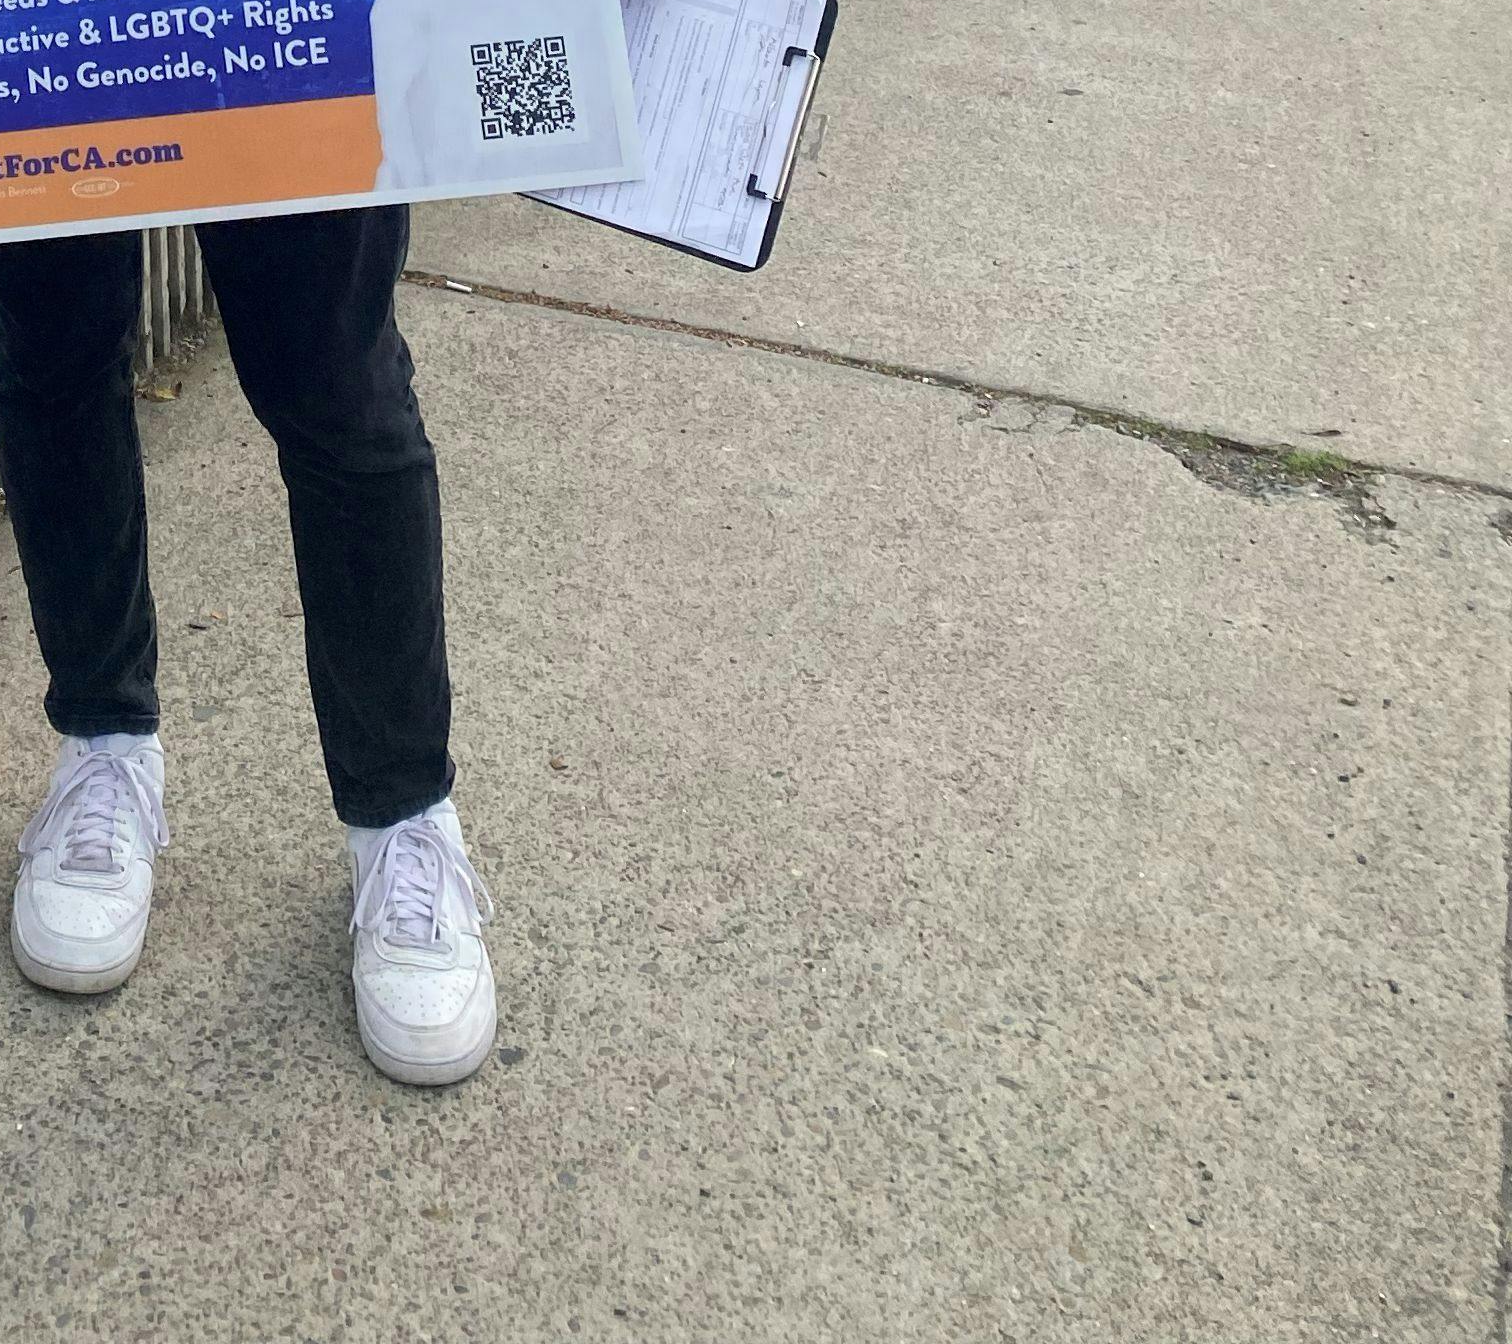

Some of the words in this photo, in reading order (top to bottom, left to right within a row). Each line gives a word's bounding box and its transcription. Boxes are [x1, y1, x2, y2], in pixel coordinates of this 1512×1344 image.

[78, 20, 102, 46] &
[109, 9, 235, 43] LGBTQ+
[28, 68, 69, 95] No
[77, 52, 217, 89] Genocide,
[225, 46, 266, 75] No
[273, 38, 329, 70] ICE
[8, 186, 47, 197] Bennett
